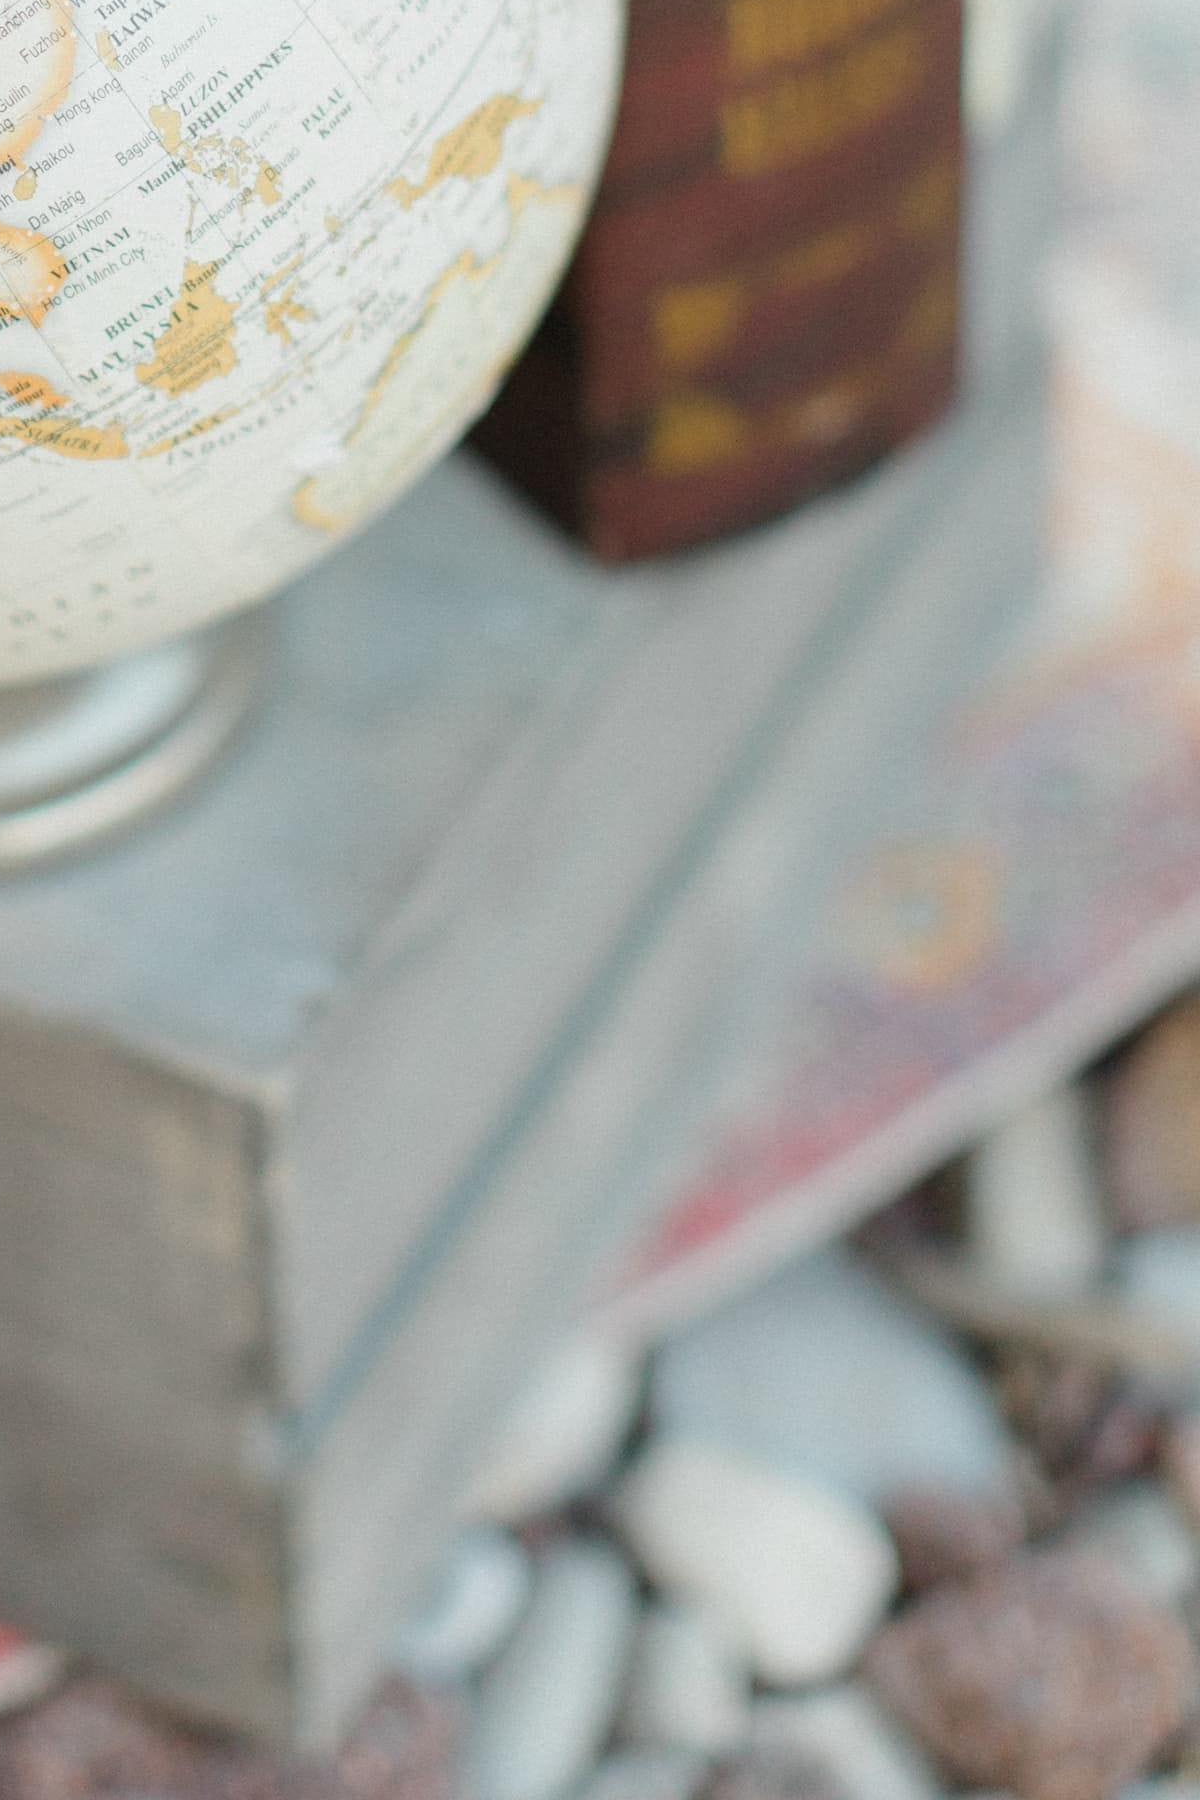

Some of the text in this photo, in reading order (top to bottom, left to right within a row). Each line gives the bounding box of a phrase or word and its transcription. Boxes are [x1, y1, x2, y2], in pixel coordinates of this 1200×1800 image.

[20, 26, 67, 64] Fuzhou
[31, 143, 75, 176] Haikou
[138, 159, 186, 197] Manila
[28, 214, 50, 231] Da
[53, 209, 113, 250] Qui Nhon
[51, 227, 131, 280] VIETNAM
[43, 246, 147, 312] Ho Chi Minh City
